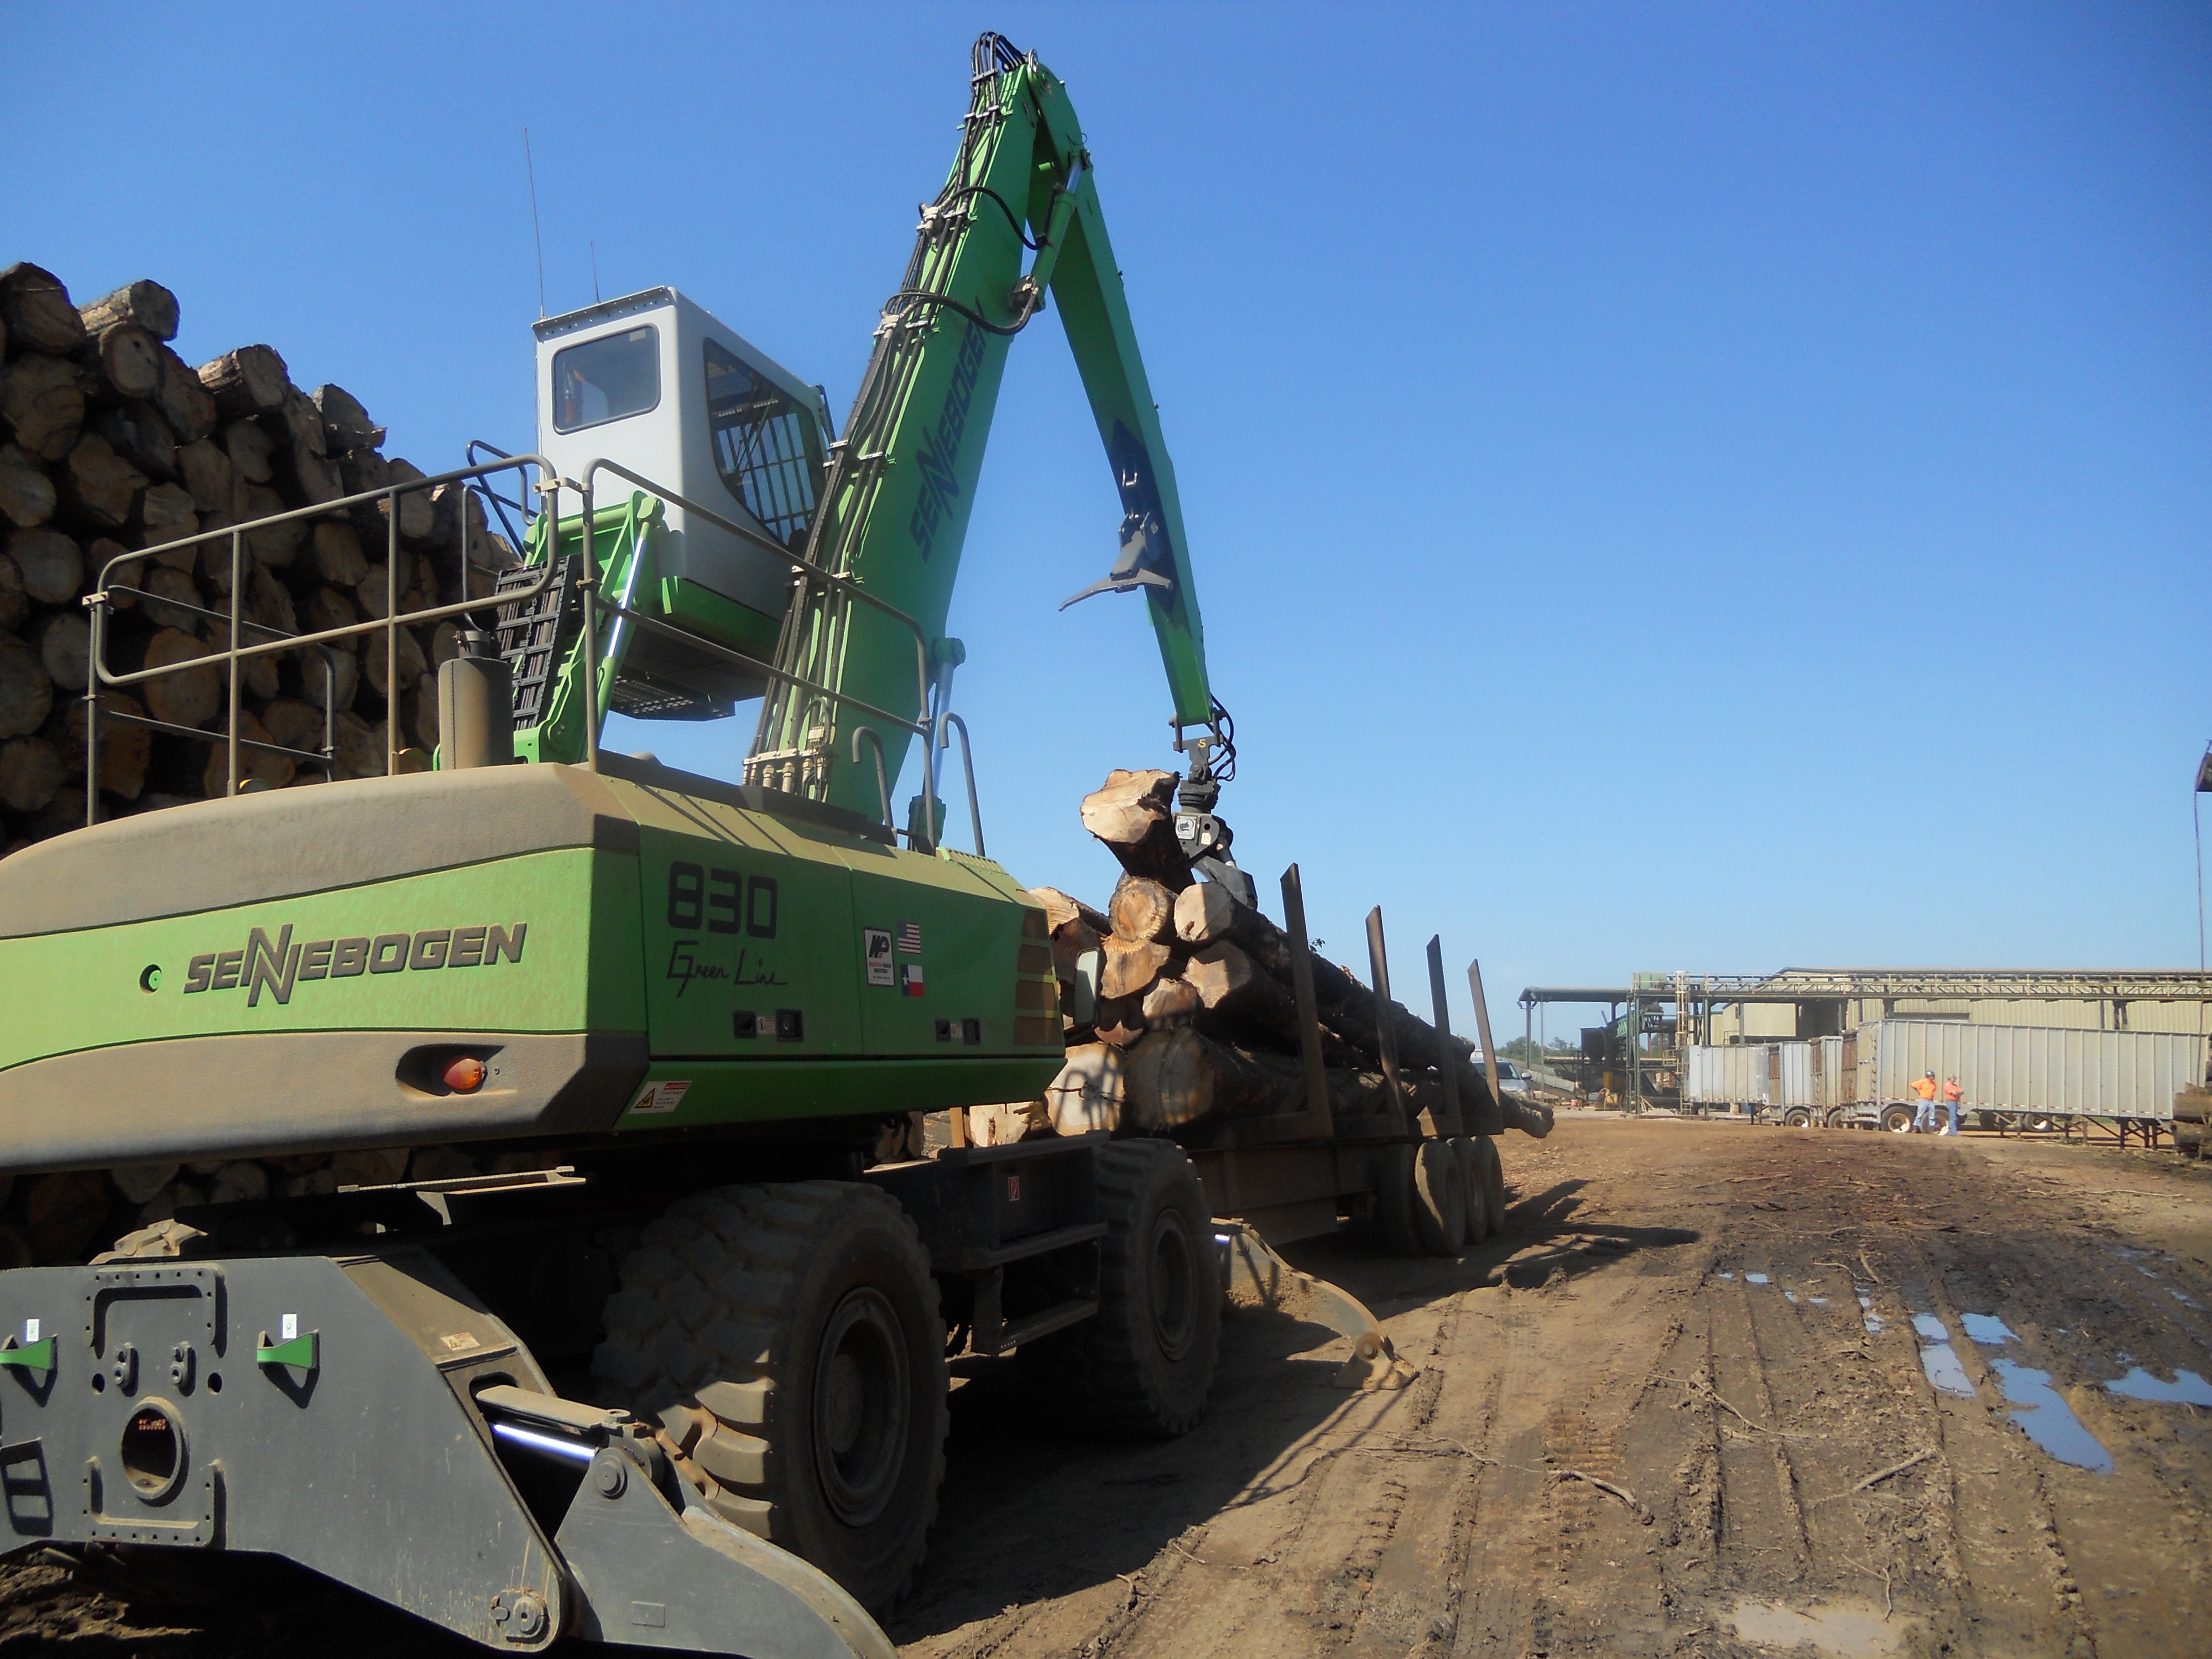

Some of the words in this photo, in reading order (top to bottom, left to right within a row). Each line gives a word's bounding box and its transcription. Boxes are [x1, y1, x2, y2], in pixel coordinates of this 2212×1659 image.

[1197, 739, 1206, 748] S
[668, 860, 778, 939] 830
[184, 923, 527, 1008] SENNEBOGEN
[667, 940, 729, 998] Green
[734, 948, 788, 985] Line
